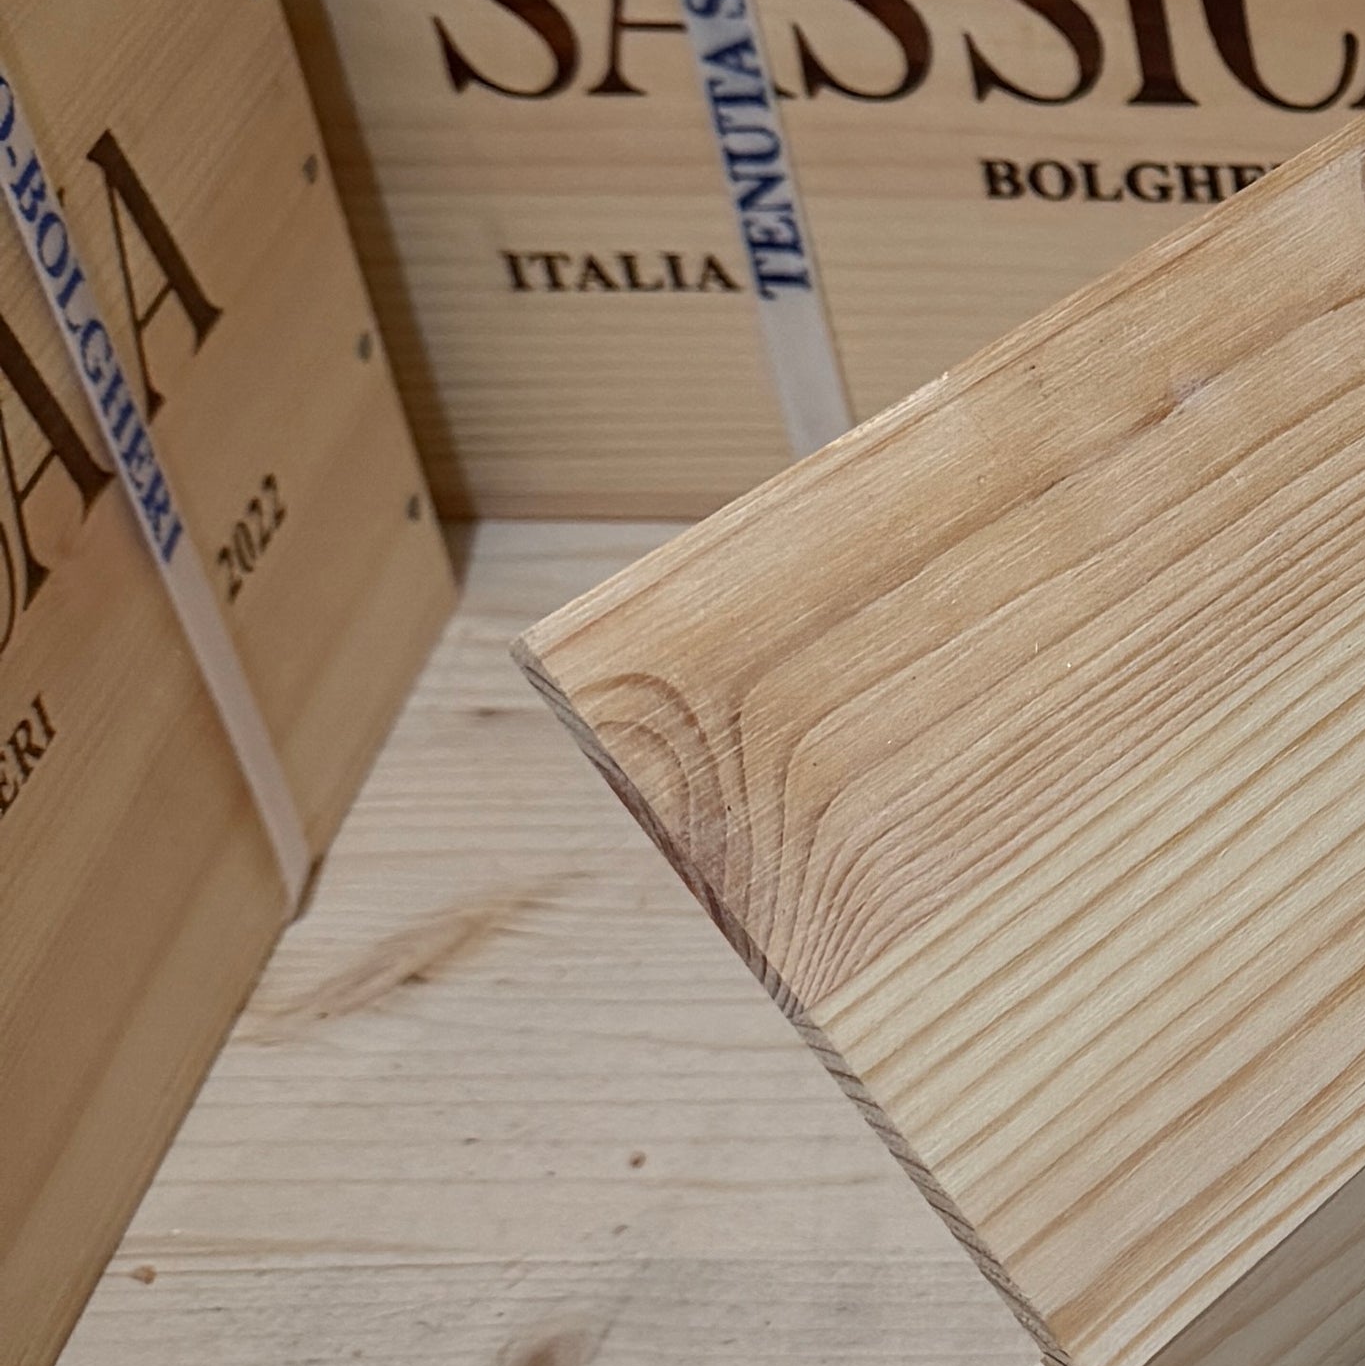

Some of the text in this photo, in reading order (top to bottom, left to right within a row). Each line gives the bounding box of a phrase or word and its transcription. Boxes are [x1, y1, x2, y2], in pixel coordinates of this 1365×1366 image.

[698, 41, 812, 300] TENUTA
[979, 157, 1284, 204] BOLGHE
[500, 251, 746, 294] ITALIA
[213, 473, 288, 603] 2022
